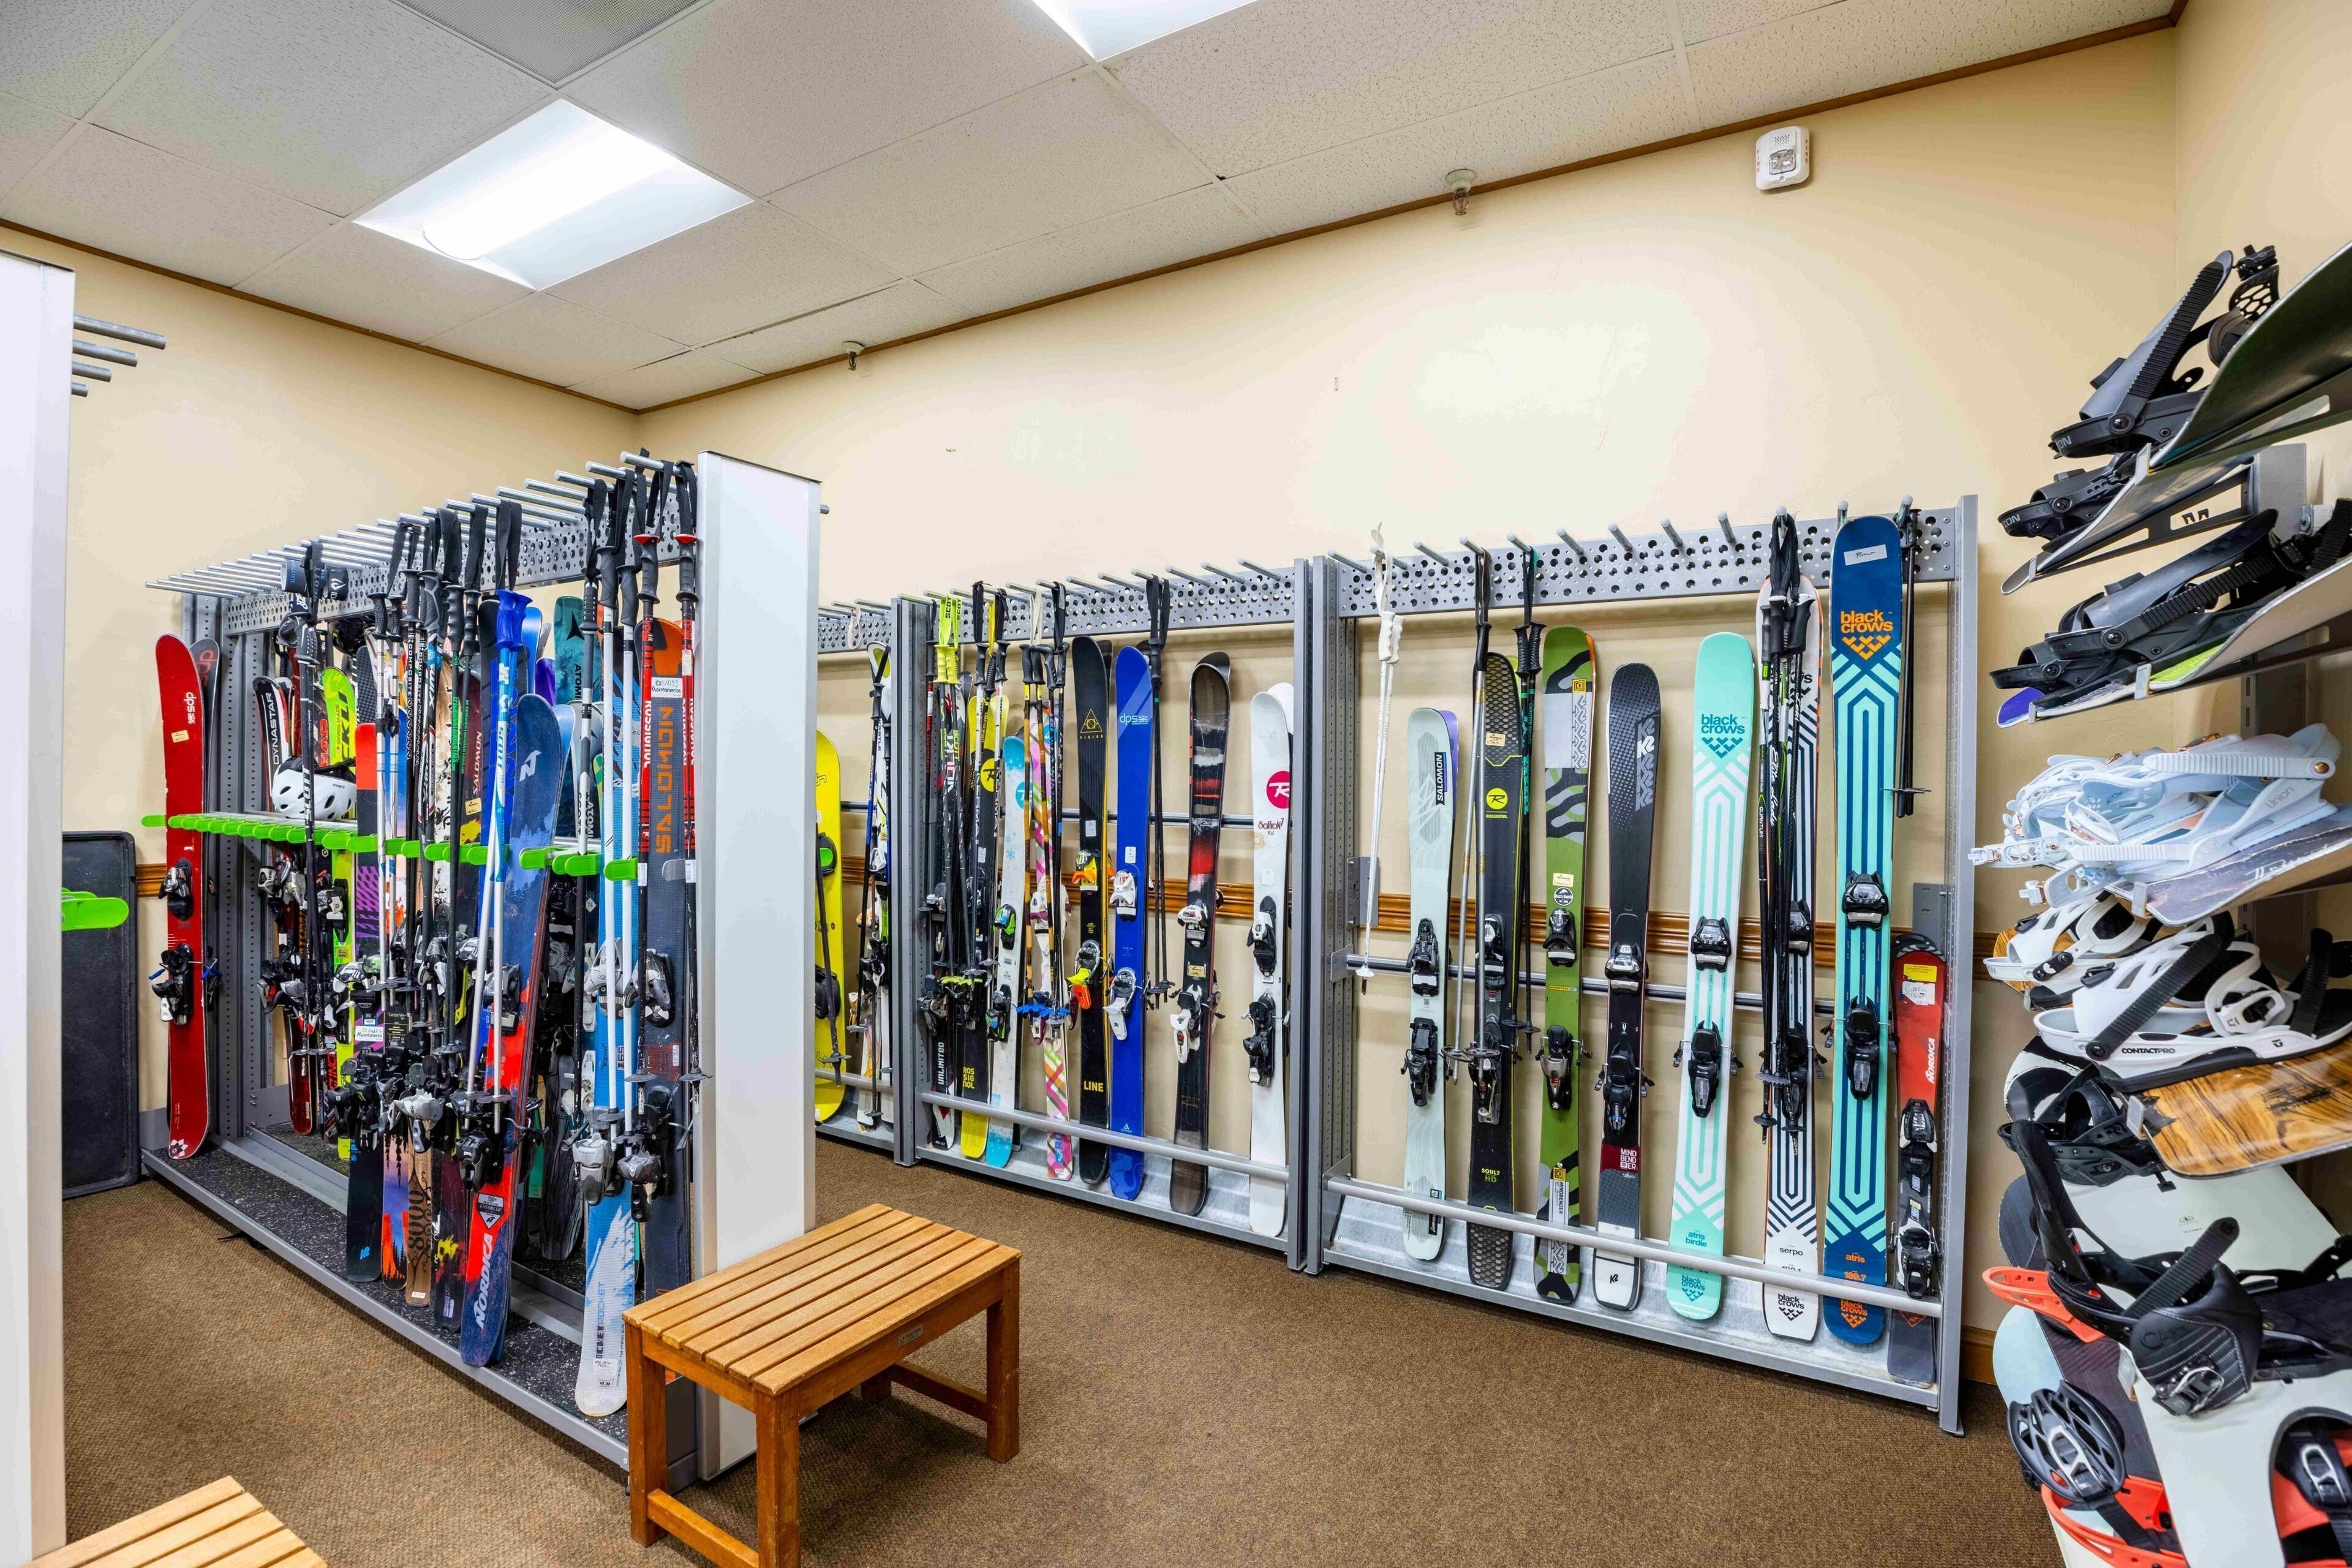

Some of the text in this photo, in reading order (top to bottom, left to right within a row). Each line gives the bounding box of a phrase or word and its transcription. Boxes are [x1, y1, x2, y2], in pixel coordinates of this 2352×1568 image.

[1841, 609, 1885, 624] black
[1841, 621, 1893, 633] crows
[1120, 712, 1138, 725] dps
[1702, 714, 1738, 725] black
[266, 692, 280, 765] DYNASTAR
[1701, 725, 1745, 734] crows
[1637, 736, 1654, 759] K2
[473, 731, 482, 796] SALOMON
[656, 706, 674, 854] SALOMON
[2266, 786, 2295, 809] Union
[1925, 1038, 1935, 1085] NORDICA
[1084, 1080, 1104, 1092] LINE
[1621, 1148, 1637, 1157] MIND
[1620, 1155, 1637, 1164] BEND
[1688, 1231, 1705, 1240] atris
[1685, 1237, 1707, 1248] birdie
[360, 1246, 371, 1260] K2
[1779, 1247, 1804, 1256] serpo
[1845, 1254, 1866, 1263] atris
[474, 1232, 493, 1330] NORDICA
[1610, 1273, 1619, 1284] K2
[1681, 1274, 1702, 1285] black
[1844, 1271, 1867, 1281] 189.7
[1681, 1281, 1706, 1291] crows
[1778, 1293, 1800, 1303] black
[1778, 1299, 1805, 1310] crows
[1841, 1298, 1863, 1310] black
[1841, 1305, 1868, 1316] crows
